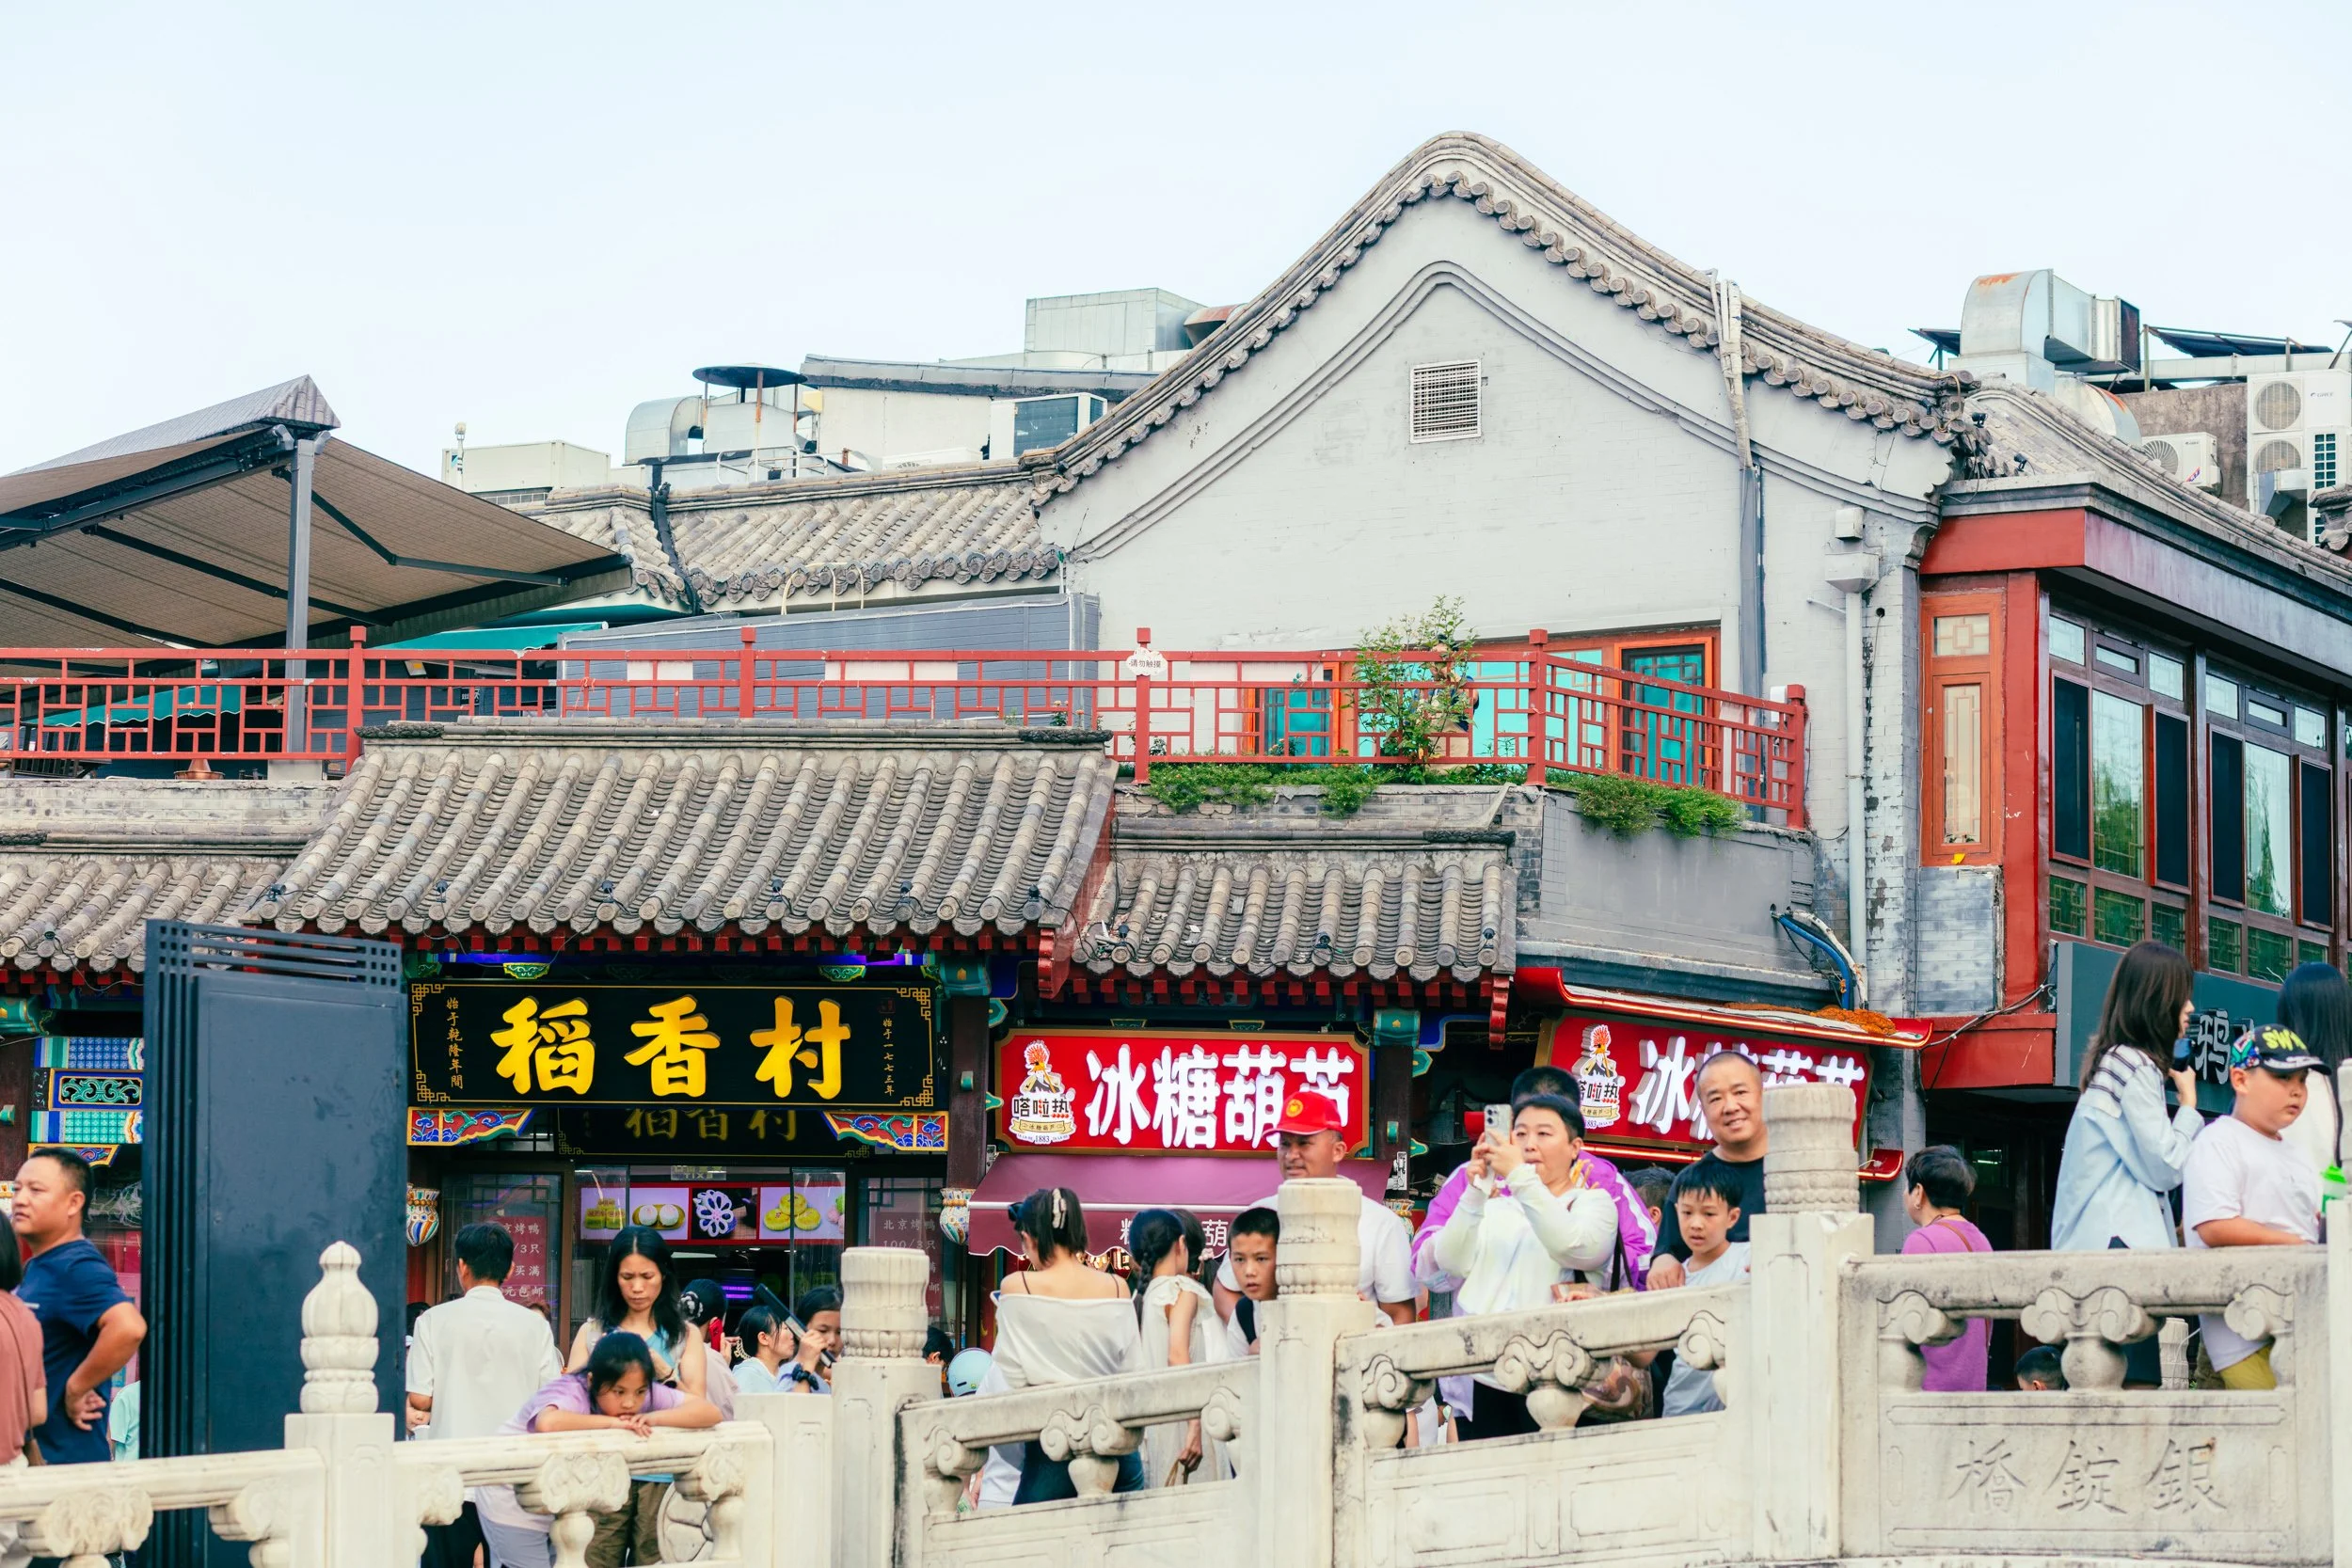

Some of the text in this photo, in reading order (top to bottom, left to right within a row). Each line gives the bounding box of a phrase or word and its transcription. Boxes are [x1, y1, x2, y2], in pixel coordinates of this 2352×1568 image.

[1130, 659, 1161, 668] 请勿触摸
[490, 995, 850, 1100] 稻香村
[883, 1219, 935, 1230] 北京烤鸭
[501, 1285, 544, 1297] 元包邮
